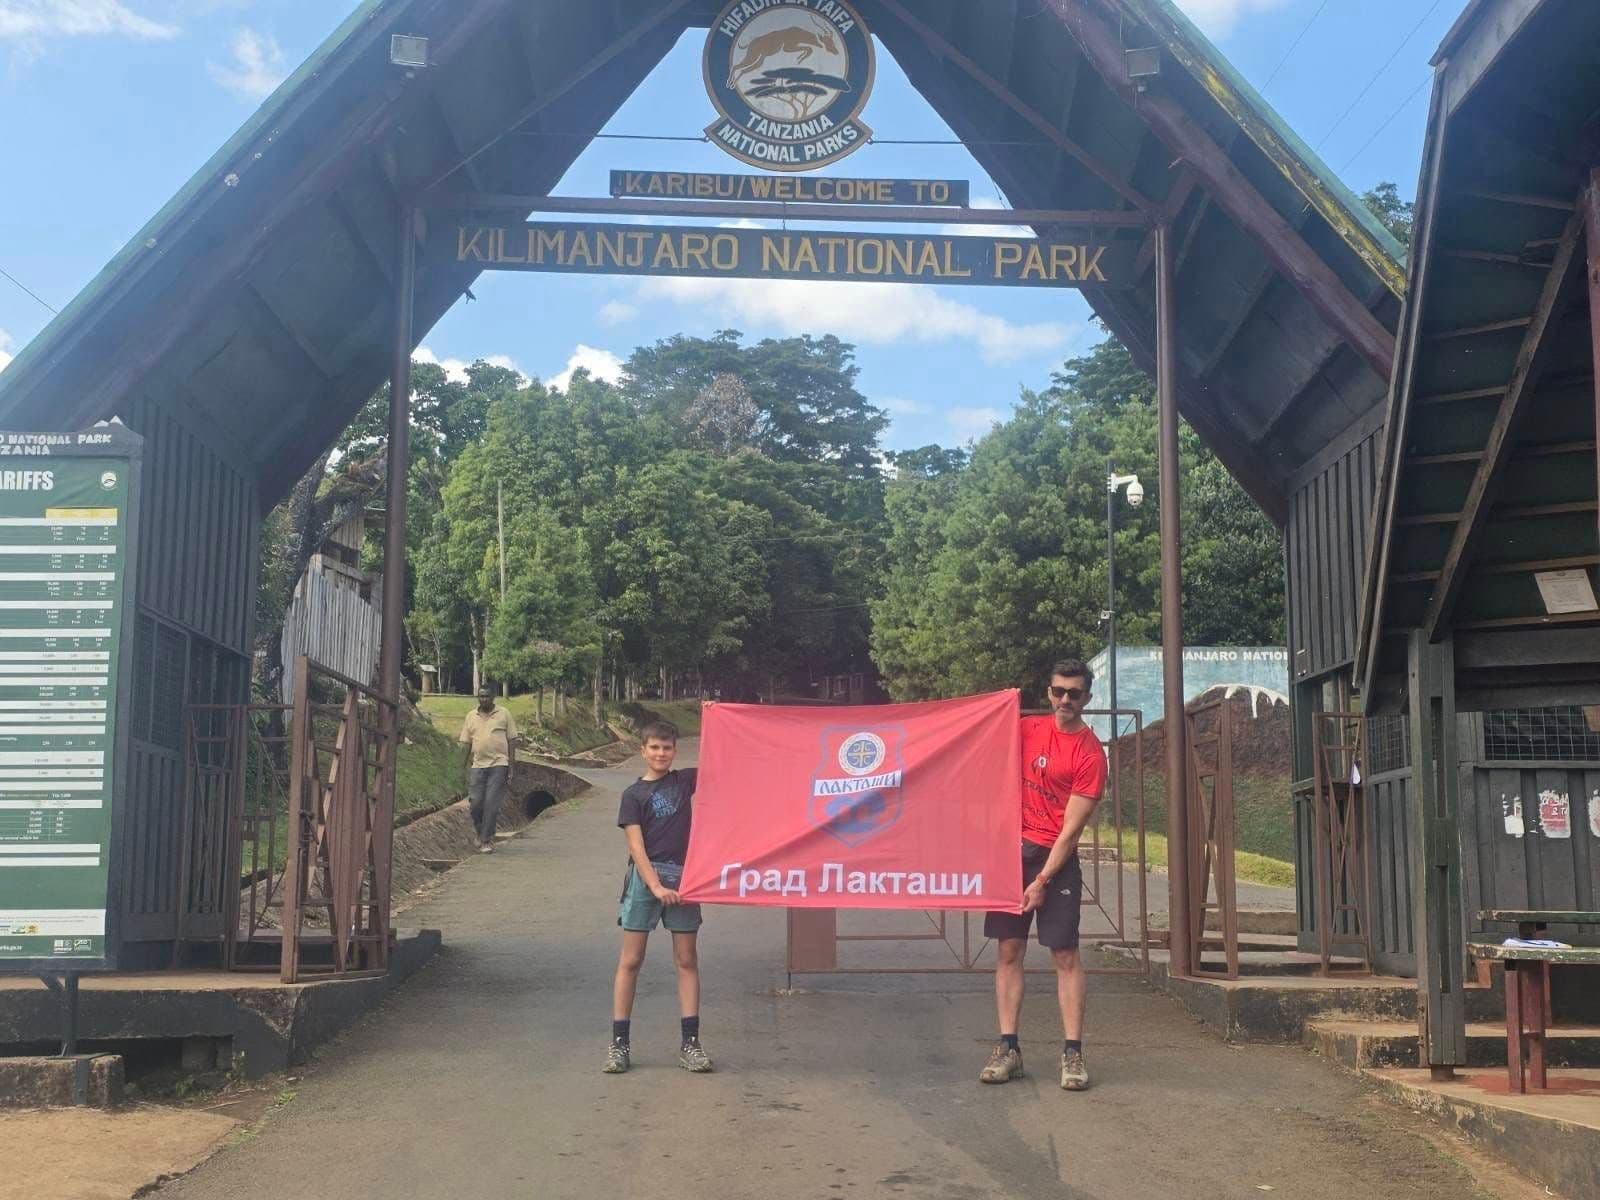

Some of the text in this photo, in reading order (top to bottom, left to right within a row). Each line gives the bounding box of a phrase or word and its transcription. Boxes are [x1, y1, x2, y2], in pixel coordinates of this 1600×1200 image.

[746, 112, 833, 140] TANZANIA
[718, 124, 858, 162] NATIONAL PARKS
[624, 173, 949, 202] KARIBU/WELCOME TO
[457, 226, 1107, 282] KILIMANJARO NATIONAL PARK
[0, 445, 50, 455] ZANIA
[8, 434, 71, 445] NATIONAL
[78, 434, 112, 444] PARK
[819, 774, 896, 795] ЛАКТАШИ
[719, 862, 983, 897] Град Лакташи
